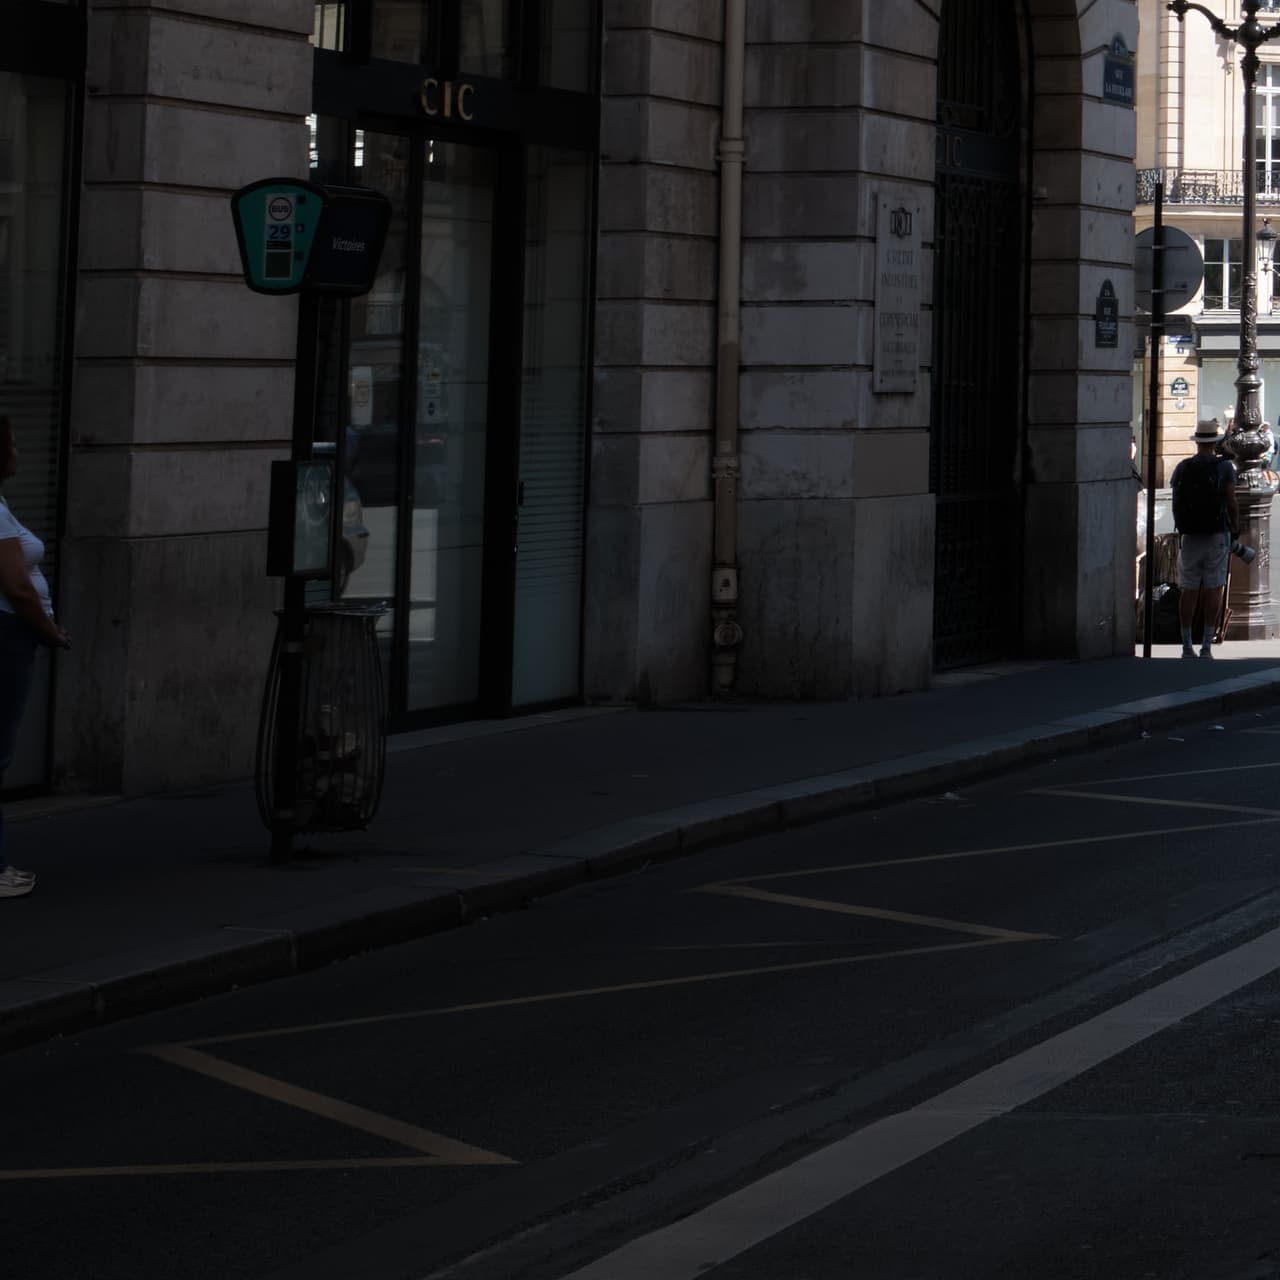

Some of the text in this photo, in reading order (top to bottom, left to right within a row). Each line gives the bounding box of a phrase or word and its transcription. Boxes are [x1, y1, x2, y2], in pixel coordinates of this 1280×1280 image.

[417, 77, 475, 121] CIC
[269, 224, 291, 240] 29
[331, 235, 367, 253] Victoires
